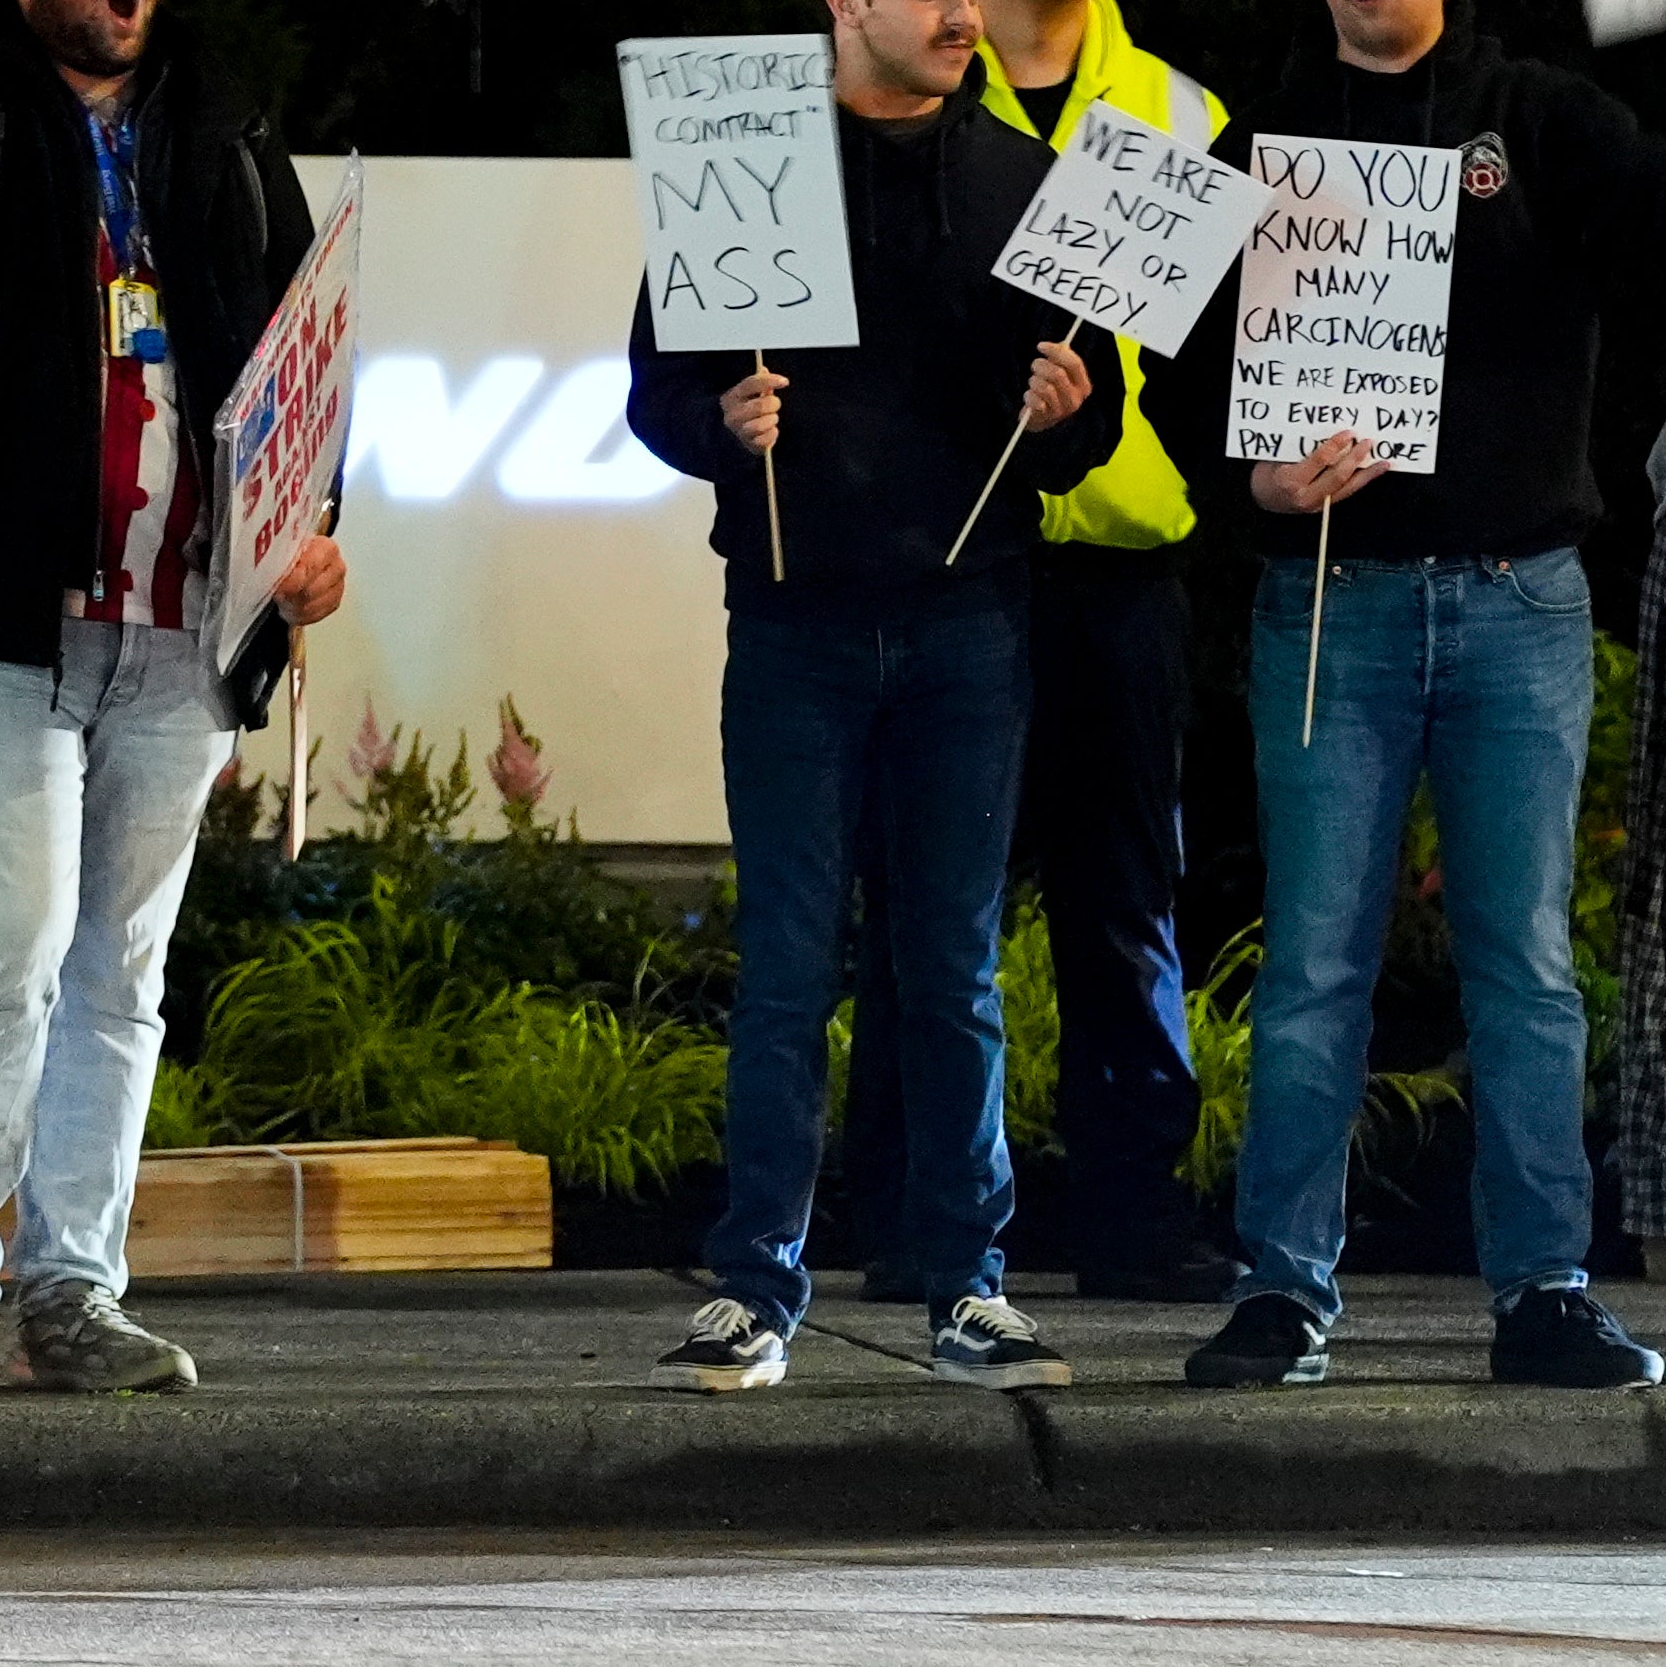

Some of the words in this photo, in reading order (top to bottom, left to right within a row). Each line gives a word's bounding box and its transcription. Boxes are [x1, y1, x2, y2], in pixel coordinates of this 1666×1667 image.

[1082, 111, 1150, 171] WE
[1152, 149, 1232, 204] ARE
[1258, 146, 1325, 200] DO
[1349, 149, 1449, 212] YOU
[652, 156, 791, 230] MY
[1104, 190, 1193, 240] NOT
[1026, 198, 1125, 268] LAZY
[1141, 254, 1188, 293] OR
[1252, 210, 1367, 257] KNOW
[1387, 220, 1454, 264] HOW
[663, 246, 812, 310] ASS
[1295, 265, 1389, 305] MANY
[278, 295, 317, 406] ON
[1243, 307, 1447, 358] CARCINOGENS
[242, 283, 348, 522] STRIKE
[1237, 358, 1285, 386] WE
[1296, 367, 1334, 387] ARE
[1343, 368, 1439, 396] EXPOSED
[1236, 398, 1270, 420] TO
[1288, 402, 1359, 426] EVERY
[1376, 406, 1439, 432] DAY?
[1239, 429, 1283, 457] PAY
